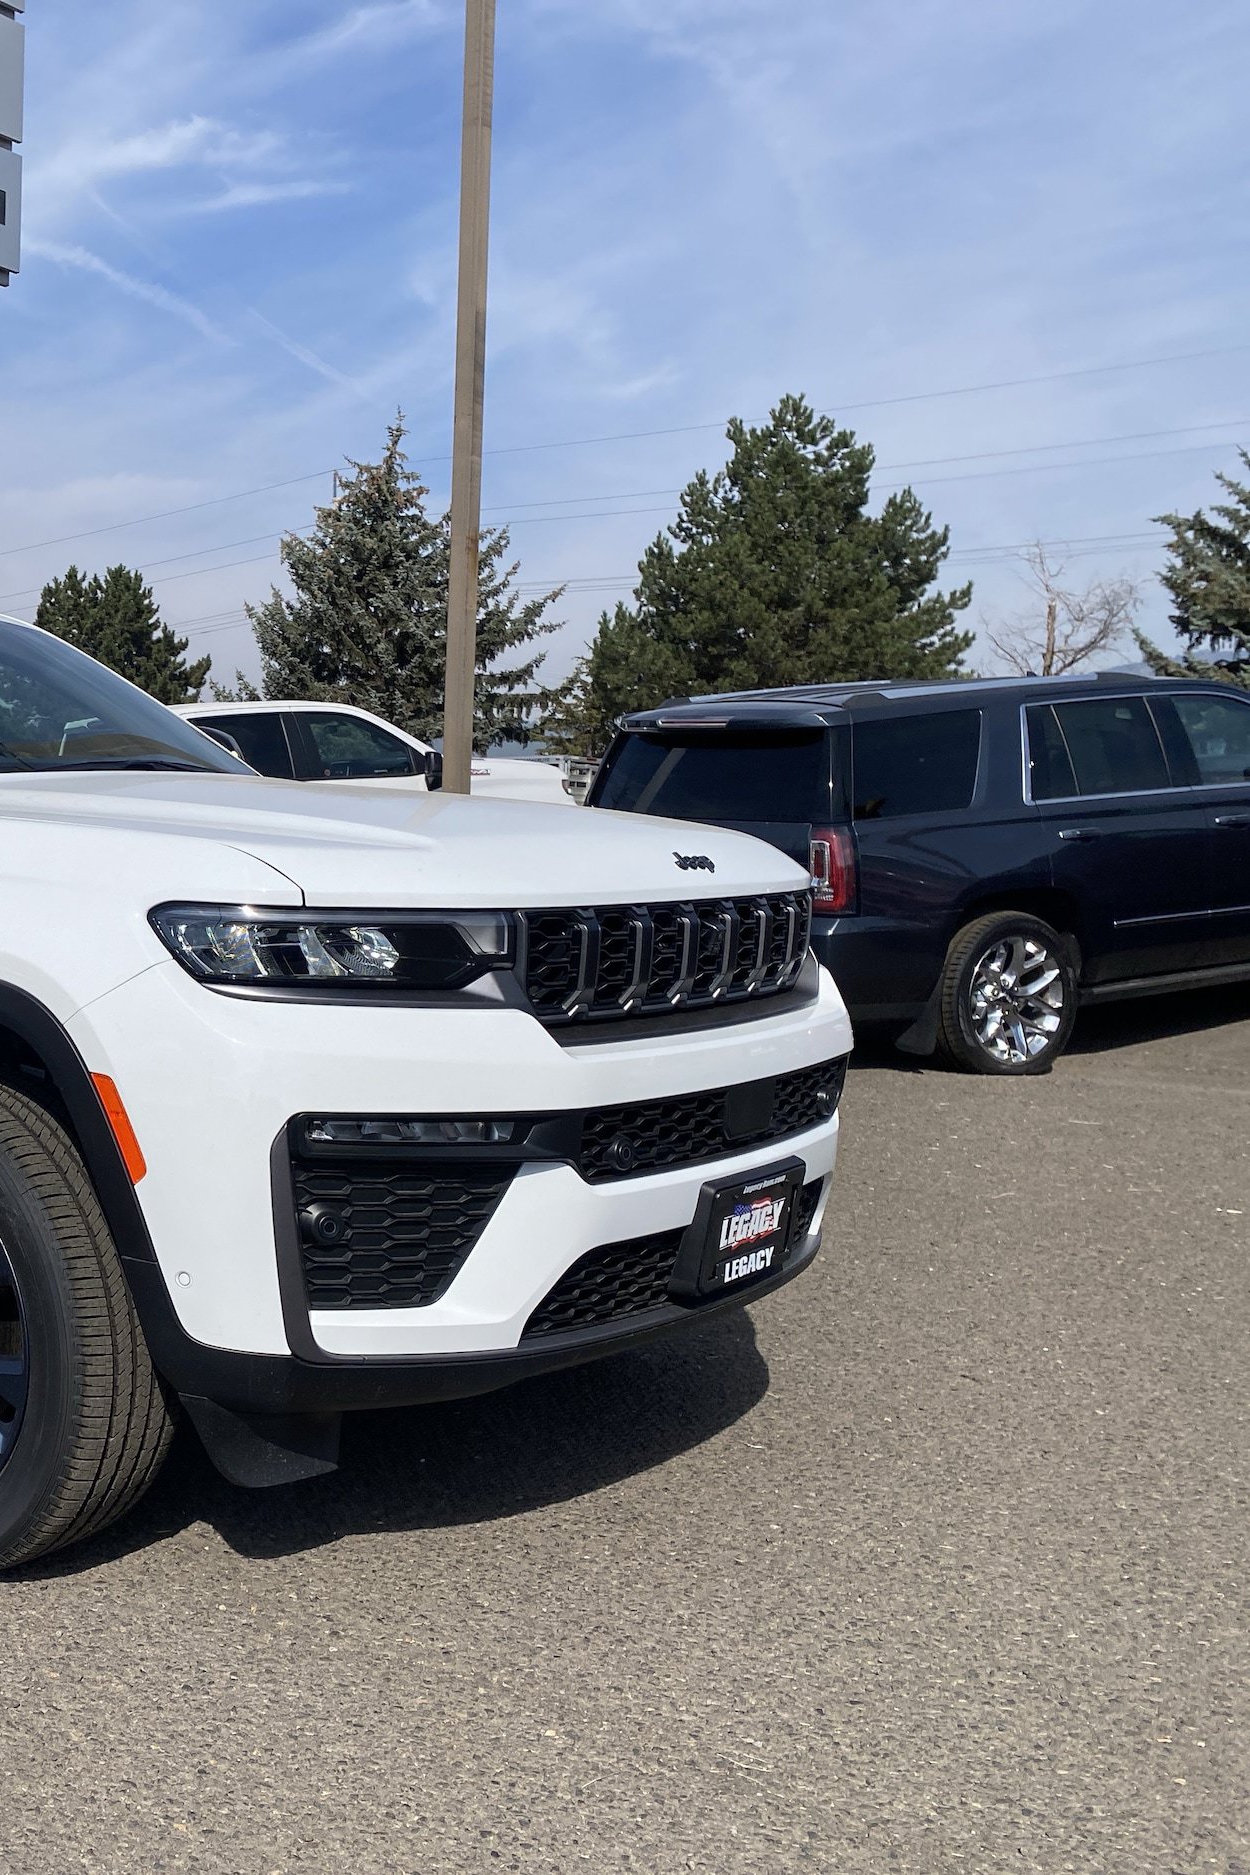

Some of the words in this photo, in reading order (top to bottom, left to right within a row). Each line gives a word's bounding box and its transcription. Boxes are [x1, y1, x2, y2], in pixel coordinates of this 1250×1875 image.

[672, 851, 716, 874] Jeep
[720, 1200, 785, 1249] LEGACY
[724, 1246, 775, 1284] LEGACY
